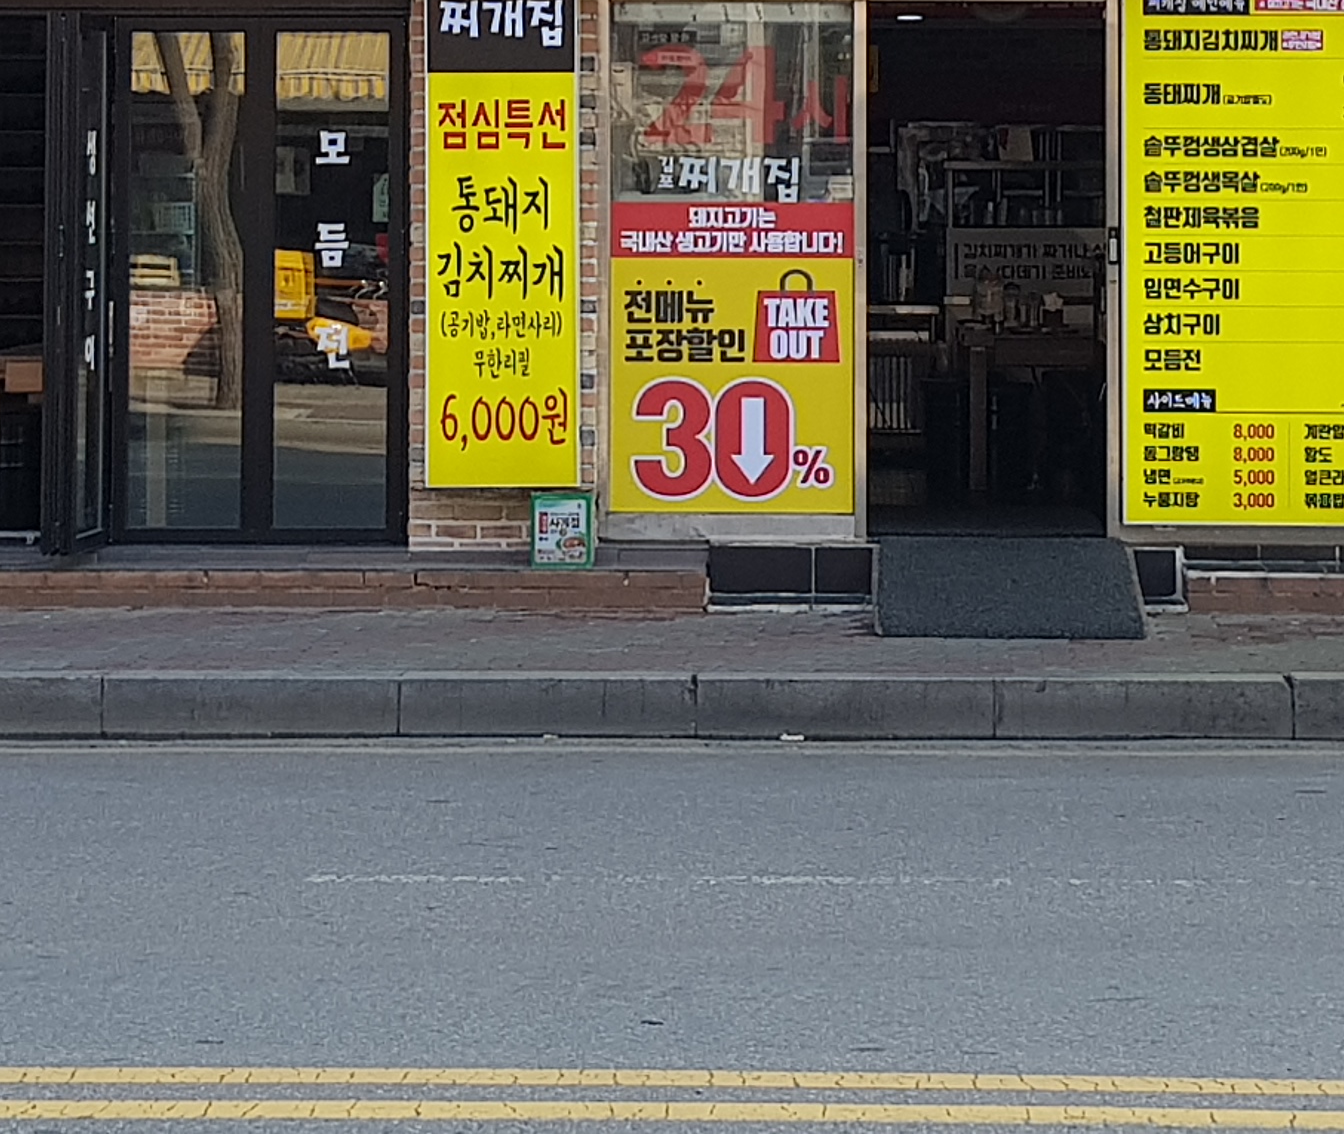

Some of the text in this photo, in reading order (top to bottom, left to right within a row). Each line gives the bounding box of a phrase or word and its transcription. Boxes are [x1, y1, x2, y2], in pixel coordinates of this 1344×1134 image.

[1143, 29, 1278, 52] 통돼지김치찌개
[640, 44, 850, 145] 24시
[1143, 83, 1221, 105] 동태찌개
[436, 98, 568, 151] 점심특선
[658, 156, 674, 188] 김포
[678, 156, 801, 203] 찌개집
[451, 175, 551, 235] 통돼지
[688, 206, 777, 229] 돼지고기는
[1143, 205, 1260, 229] 철판제육볶음
[315, 128, 351, 370] 모듬전
[620, 231, 844, 254] 국내산 생고기만 사용합니다!
[1143, 242, 1240, 265] 고등어구이
[436, 243, 565, 302] 김치찌개
[623, 289, 716, 326] 전메뉴
[764, 298, 830, 329] TAKE
[1142, 313, 1221, 336] 삼치구이
[623, 327, 747, 364] 포장할인
[769, 328, 824, 361] OUT
[472, 348, 531, 380] 무한리필
[1143, 349, 1201, 371] 모듬전
[1146, 392, 1213, 409] 사이드메뉴
[440, 387, 569, 450] 6,000원
[1143, 422, 1275, 442] 떡갈비 8,000
[1233, 446, 1275, 465] 8,000
[1143, 468, 1171, 486] 냉면
[1233, 469, 1275, 488] 5,000
[1143, 492, 1275, 512] 누룽지탕 3,000
